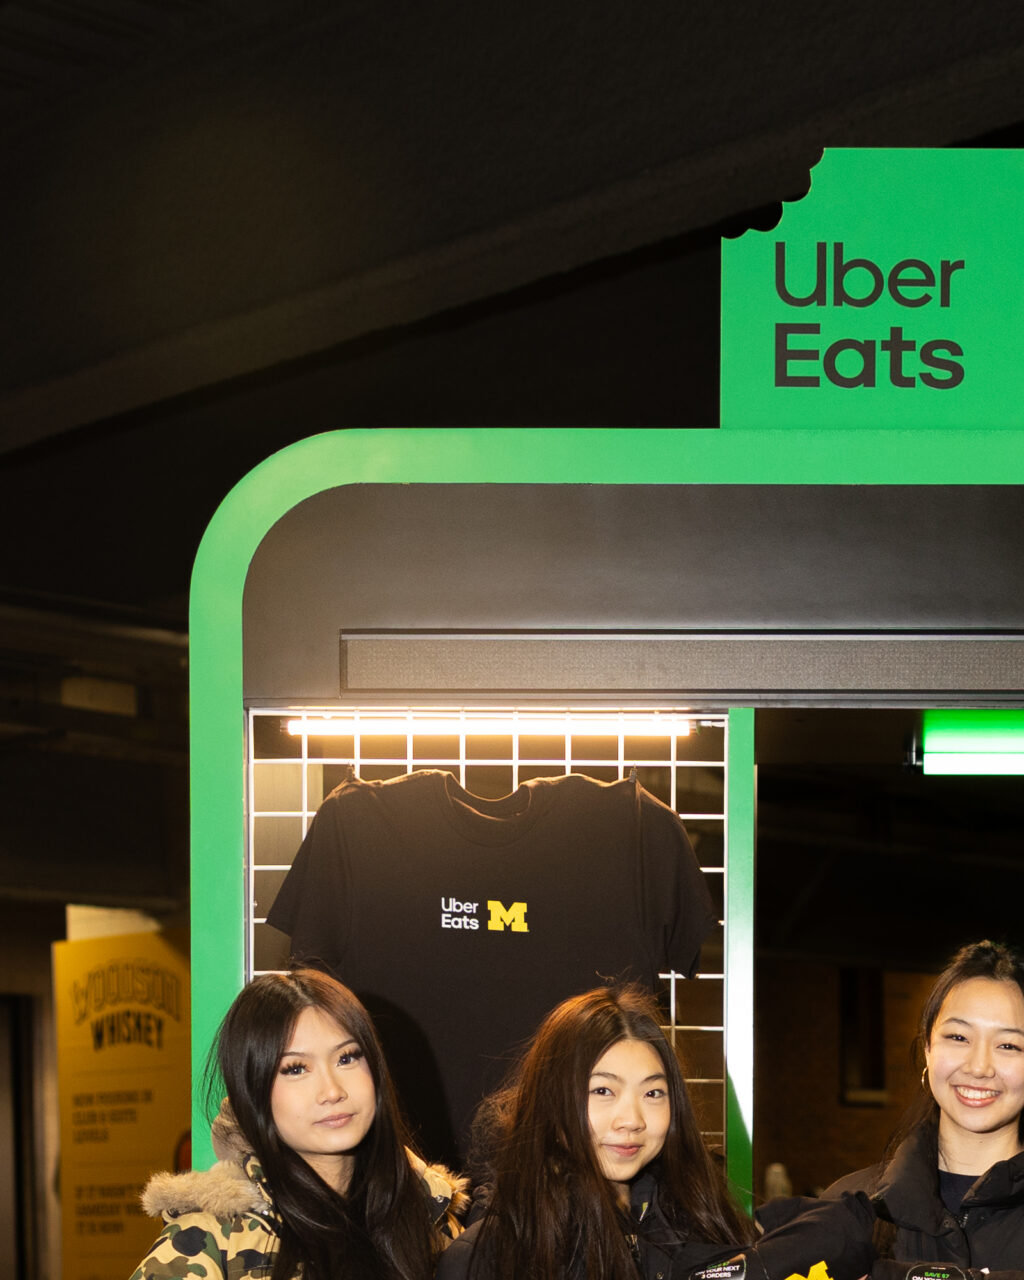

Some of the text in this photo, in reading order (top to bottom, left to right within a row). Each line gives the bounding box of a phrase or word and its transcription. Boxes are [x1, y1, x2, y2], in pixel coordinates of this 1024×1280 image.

[774, 241, 965, 308] Uber
[774, 322, 966, 389] Eats
[441, 897, 480, 914] Uber
[441, 913, 480, 930] Eats
[487, 900, 528, 932] M
[70, 963, 181, 1024] WOODSON
[91, 1010, 165, 1050] WHISKEY
